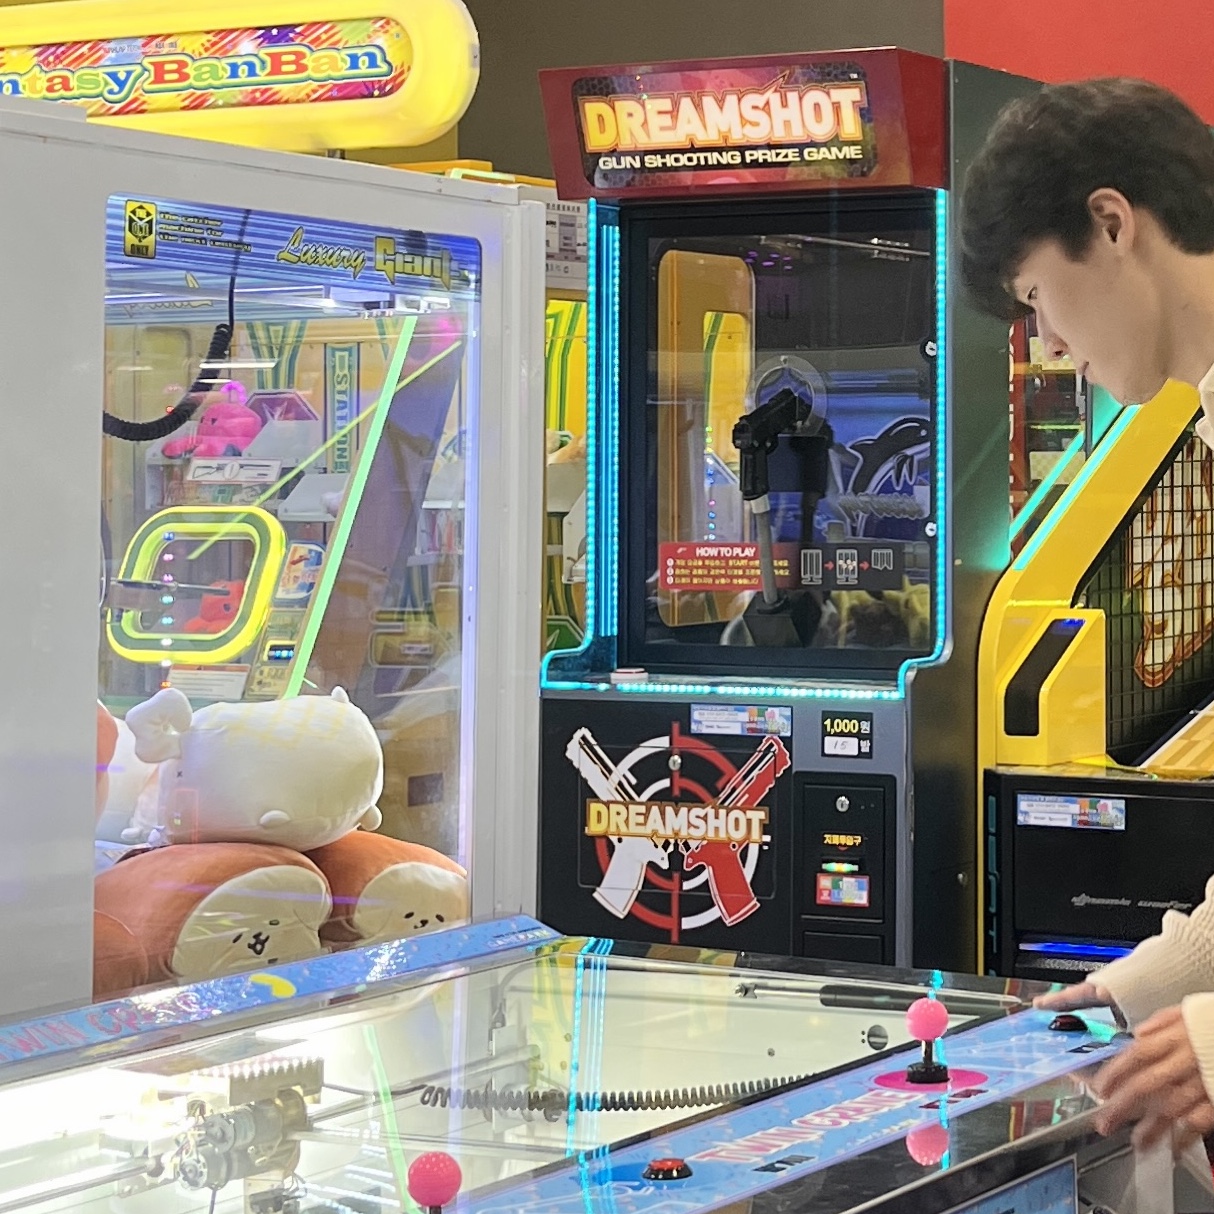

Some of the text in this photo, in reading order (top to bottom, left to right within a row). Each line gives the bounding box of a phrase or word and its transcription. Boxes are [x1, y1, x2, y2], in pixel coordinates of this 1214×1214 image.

[582, 82, 863, 149] DREAMSHOT
[599, 146, 863, 170] GUN SHOOTING PRIZE GAME
[276, 226, 366, 280] Luxury
[695, 547, 756, 557] HOW TO PLAY
[588, 803, 767, 840] DREAMSHOT
